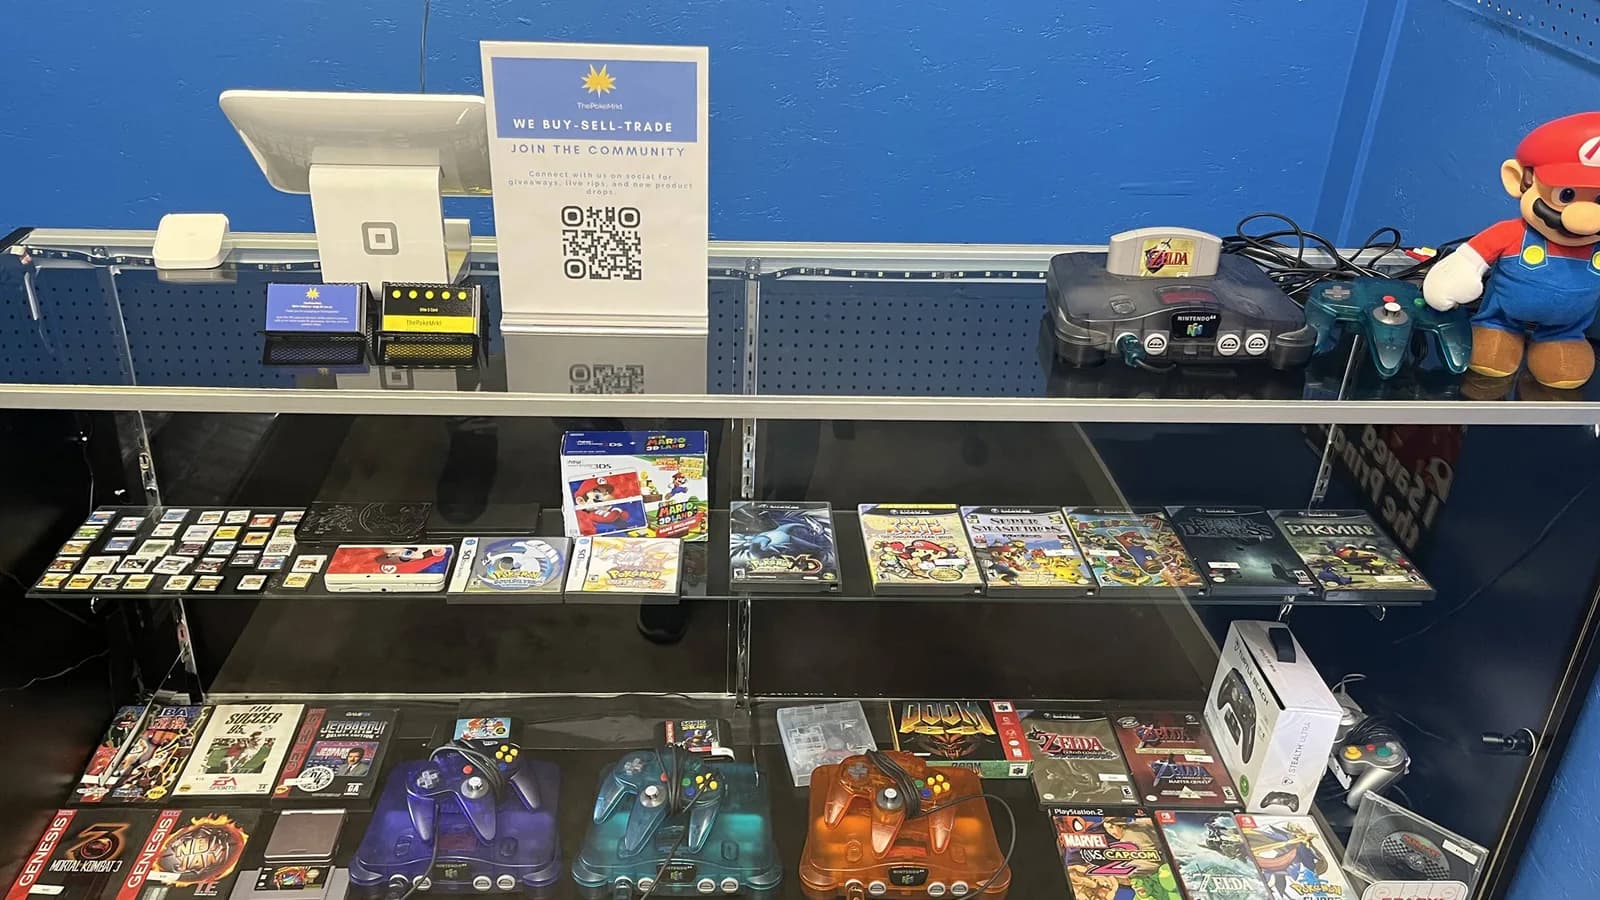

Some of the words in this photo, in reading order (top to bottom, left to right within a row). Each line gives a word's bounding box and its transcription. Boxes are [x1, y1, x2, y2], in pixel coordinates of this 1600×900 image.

[513, 118, 535, 129] WE
[542, 119, 673, 132] BUY-SELL-TRADE
[511, 144, 546, 154] JOIN
[553, 145, 580, 155] THE
[588, 145, 686, 158] COMMUNITY
[528, 170, 569, 178] Connect
[573, 171, 593, 179] with
[626, 172, 655, 181] social
[658, 173, 672, 181] for
[508, 178, 561, 187] giveaways,
[612, 180, 629, 188] and
[655, 182, 693, 191] product
[586, 188, 616, 197] drops.
[1147, 250, 1188, 268] ZELDA
[647, 437, 686, 446] MARIO
[659, 502, 693, 517] MARIO
[672, 511, 693, 522] LAND
[1286, 525, 1375, 535] PIKMIN
[225, 712, 283, 725] SOCCER
[899, 702, 997, 736] DOOM
[320, 720, 388, 734] JEOPARDY!
[1036, 732, 1105, 753] ZELDA
[1288, 744, 1303, 774] STEALTH
[212, 777, 238, 787] EA
[1063, 834, 1106, 848] MARVEL
[19, 817, 67, 887] GENESIS
[127, 818, 173, 888] GENESIS
[1105, 850, 1160, 861] CAPCOM
[49, 860, 79, 872] MORTAL
[80, 860, 114, 872] KOMBAT
[1193, 873, 1253, 893] ZELDA
